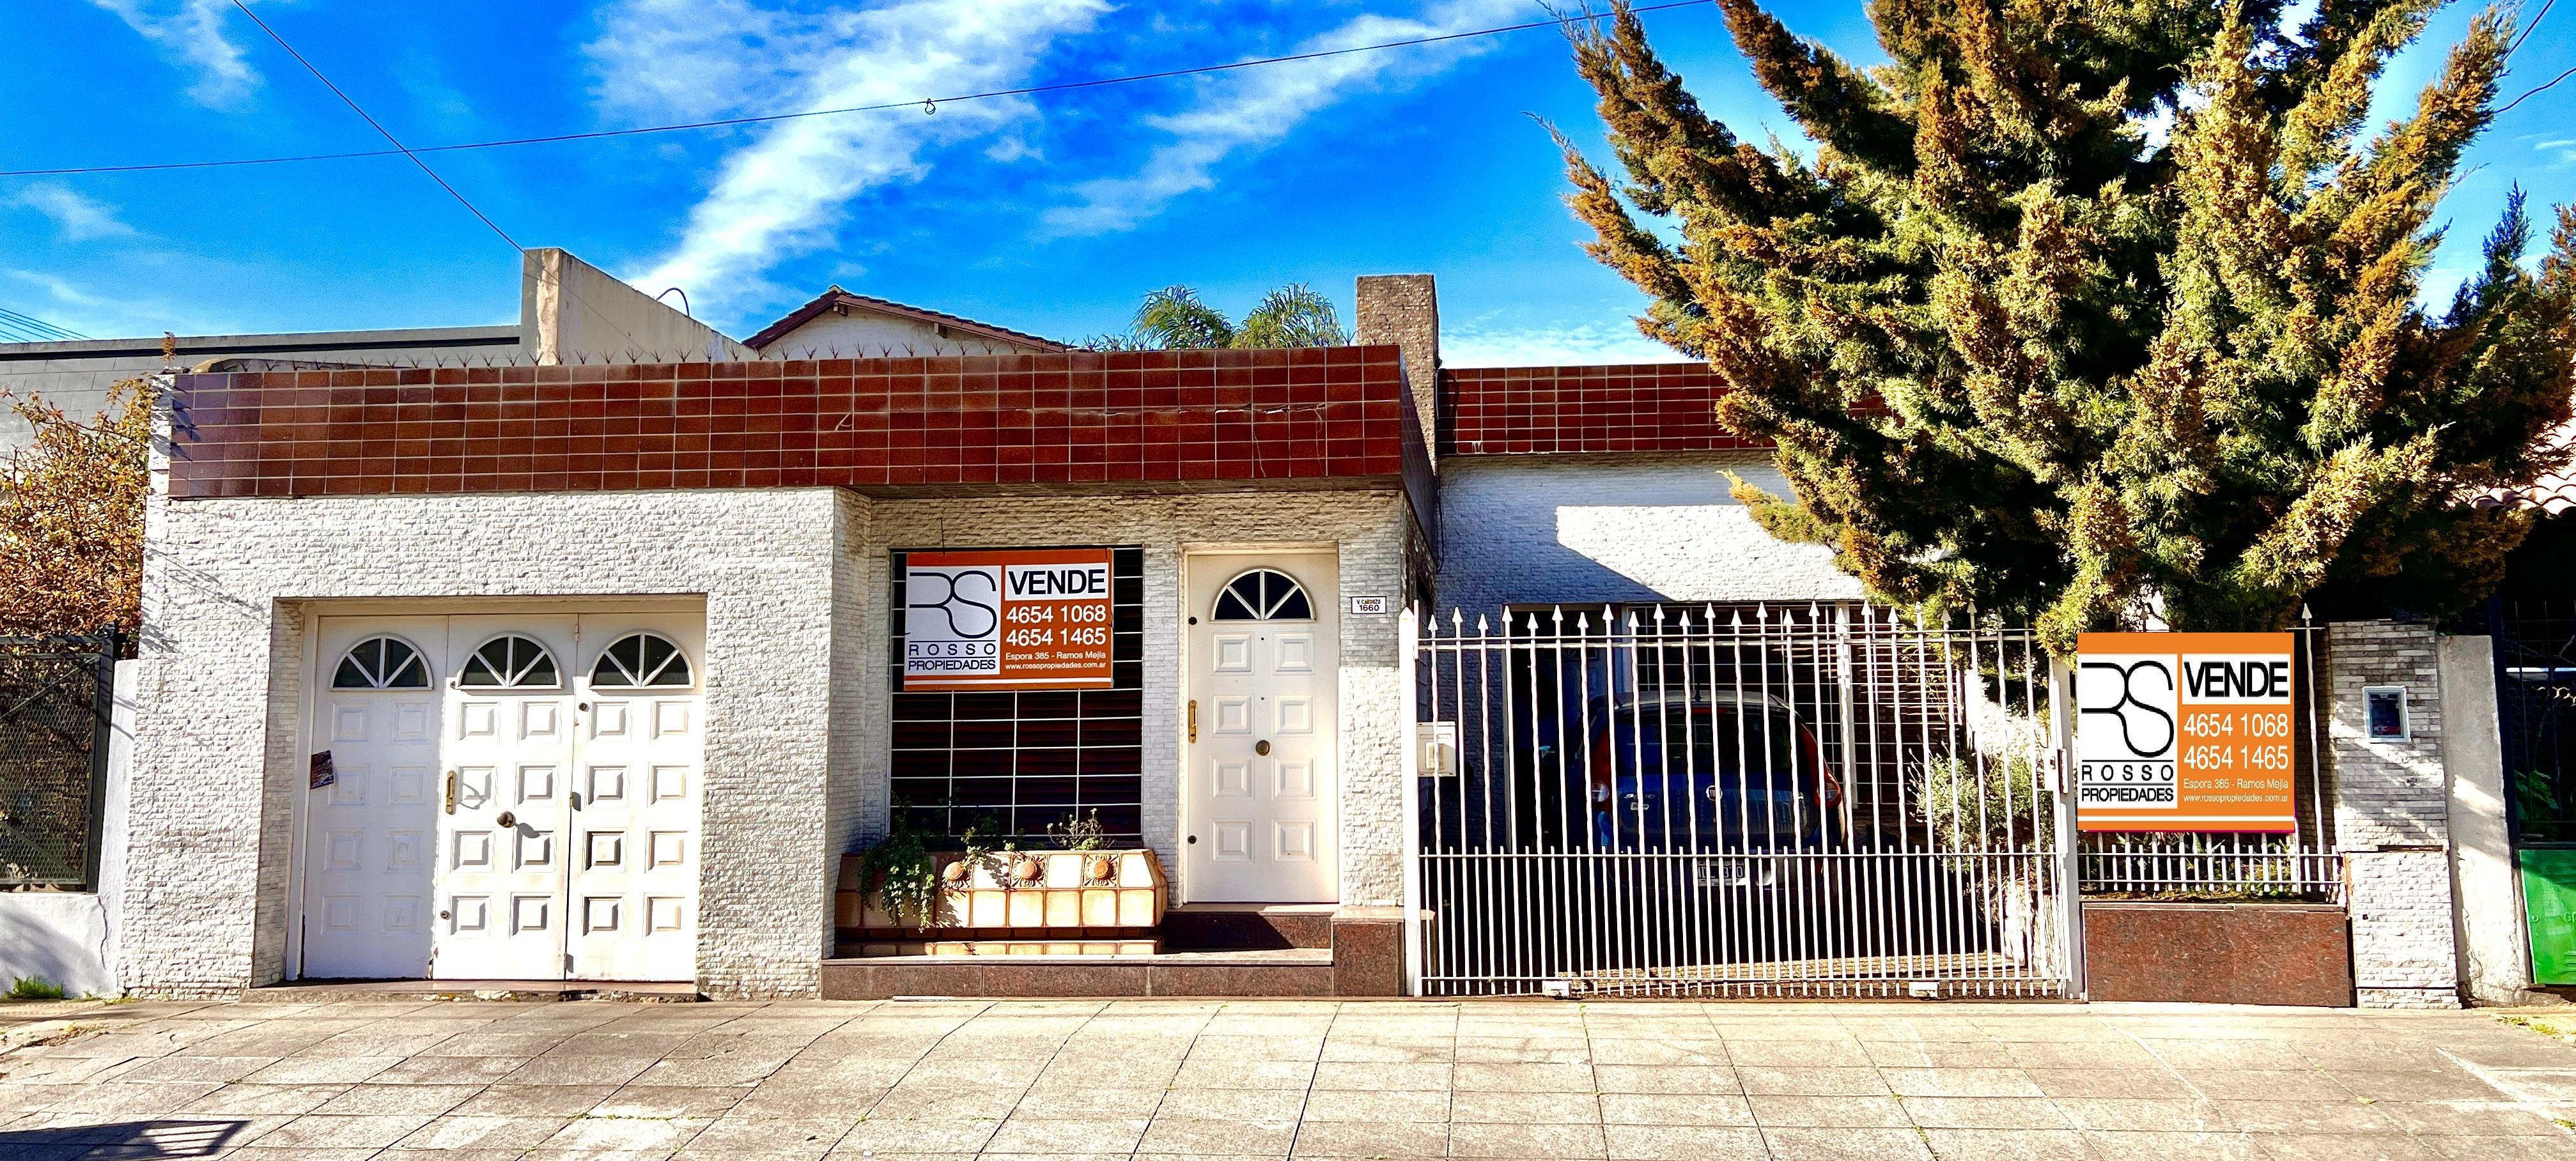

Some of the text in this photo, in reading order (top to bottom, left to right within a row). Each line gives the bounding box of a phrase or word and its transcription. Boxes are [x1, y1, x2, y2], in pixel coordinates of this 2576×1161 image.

[1008, 569, 1106, 595] VENDE
[1006, 604, 1106, 624] 4654 1068
[1005, 627, 1106, 647] 4654 1465
[909, 643, 996, 656] ROSSO
[1005, 652, 1033, 661] Espora
[1057, 651, 1083, 659] Ramos
[908, 659, 996, 670] PROPIEDADES
[1005, 662, 1106, 670] www.rossopropiedades.com.ar
[2184, 661, 2288, 697] VENDE
[2184, 713, 2288, 737] 4654 1068
[2184, 746, 2288, 769] 4654 1465
[2082, 764, 2173, 781] ROSSO
[2184, 778, 2212, 790] Espora
[2214, 778, 2230, 788] 385
[2237, 778, 2265, 788] Ramos
[2267, 778, 2288, 790] Mejía
[2082, 788, 2173, 802] PROPIEDADES
[2184, 794, 2289, 803] www.rossopropiedades.com.ar
